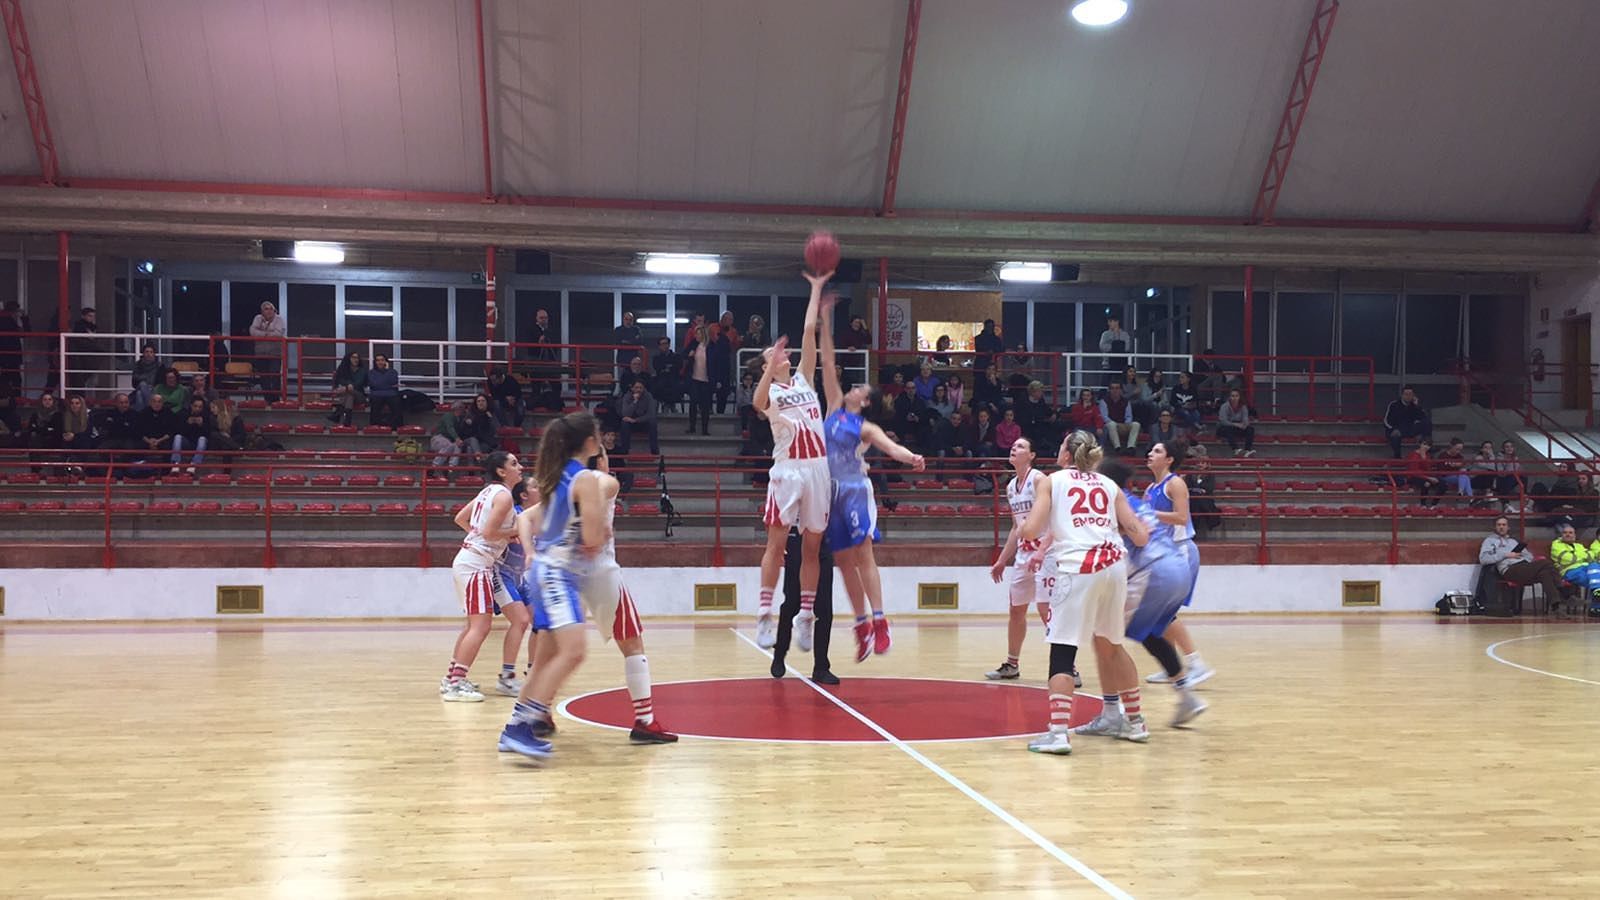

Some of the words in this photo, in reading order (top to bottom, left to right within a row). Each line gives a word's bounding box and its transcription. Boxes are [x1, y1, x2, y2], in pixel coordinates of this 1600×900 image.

[776, 391, 815, 407] SCOTTI
[806, 407, 820, 420] 18
[1067, 486, 1109, 515] 20
[850, 510, 859, 527] 3
[1041, 576, 1056, 588] 10
